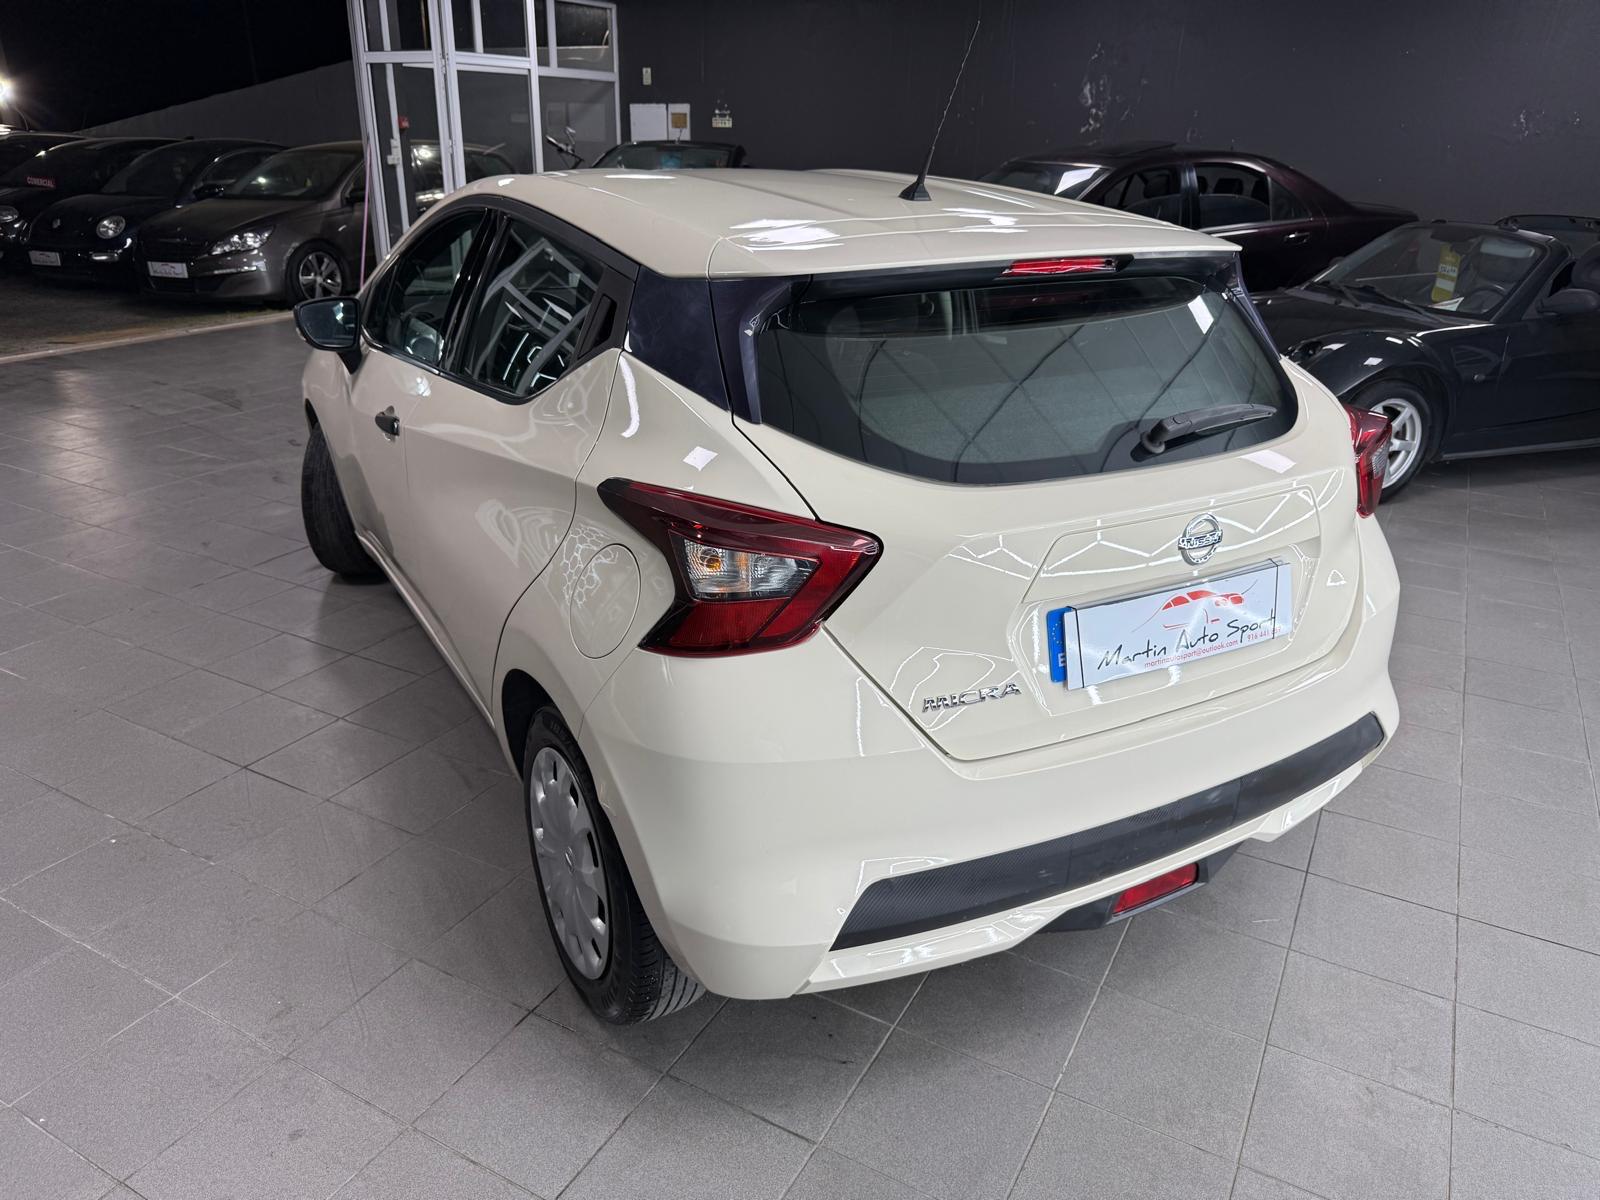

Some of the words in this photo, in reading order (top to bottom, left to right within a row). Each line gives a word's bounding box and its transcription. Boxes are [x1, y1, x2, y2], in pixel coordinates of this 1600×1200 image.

[1096, 639, 1167, 670] Martin
[1175, 627, 1219, 652] Auto
[1226, 608, 1275, 644] Sport
[922, 683, 1022, 713] MICRA
